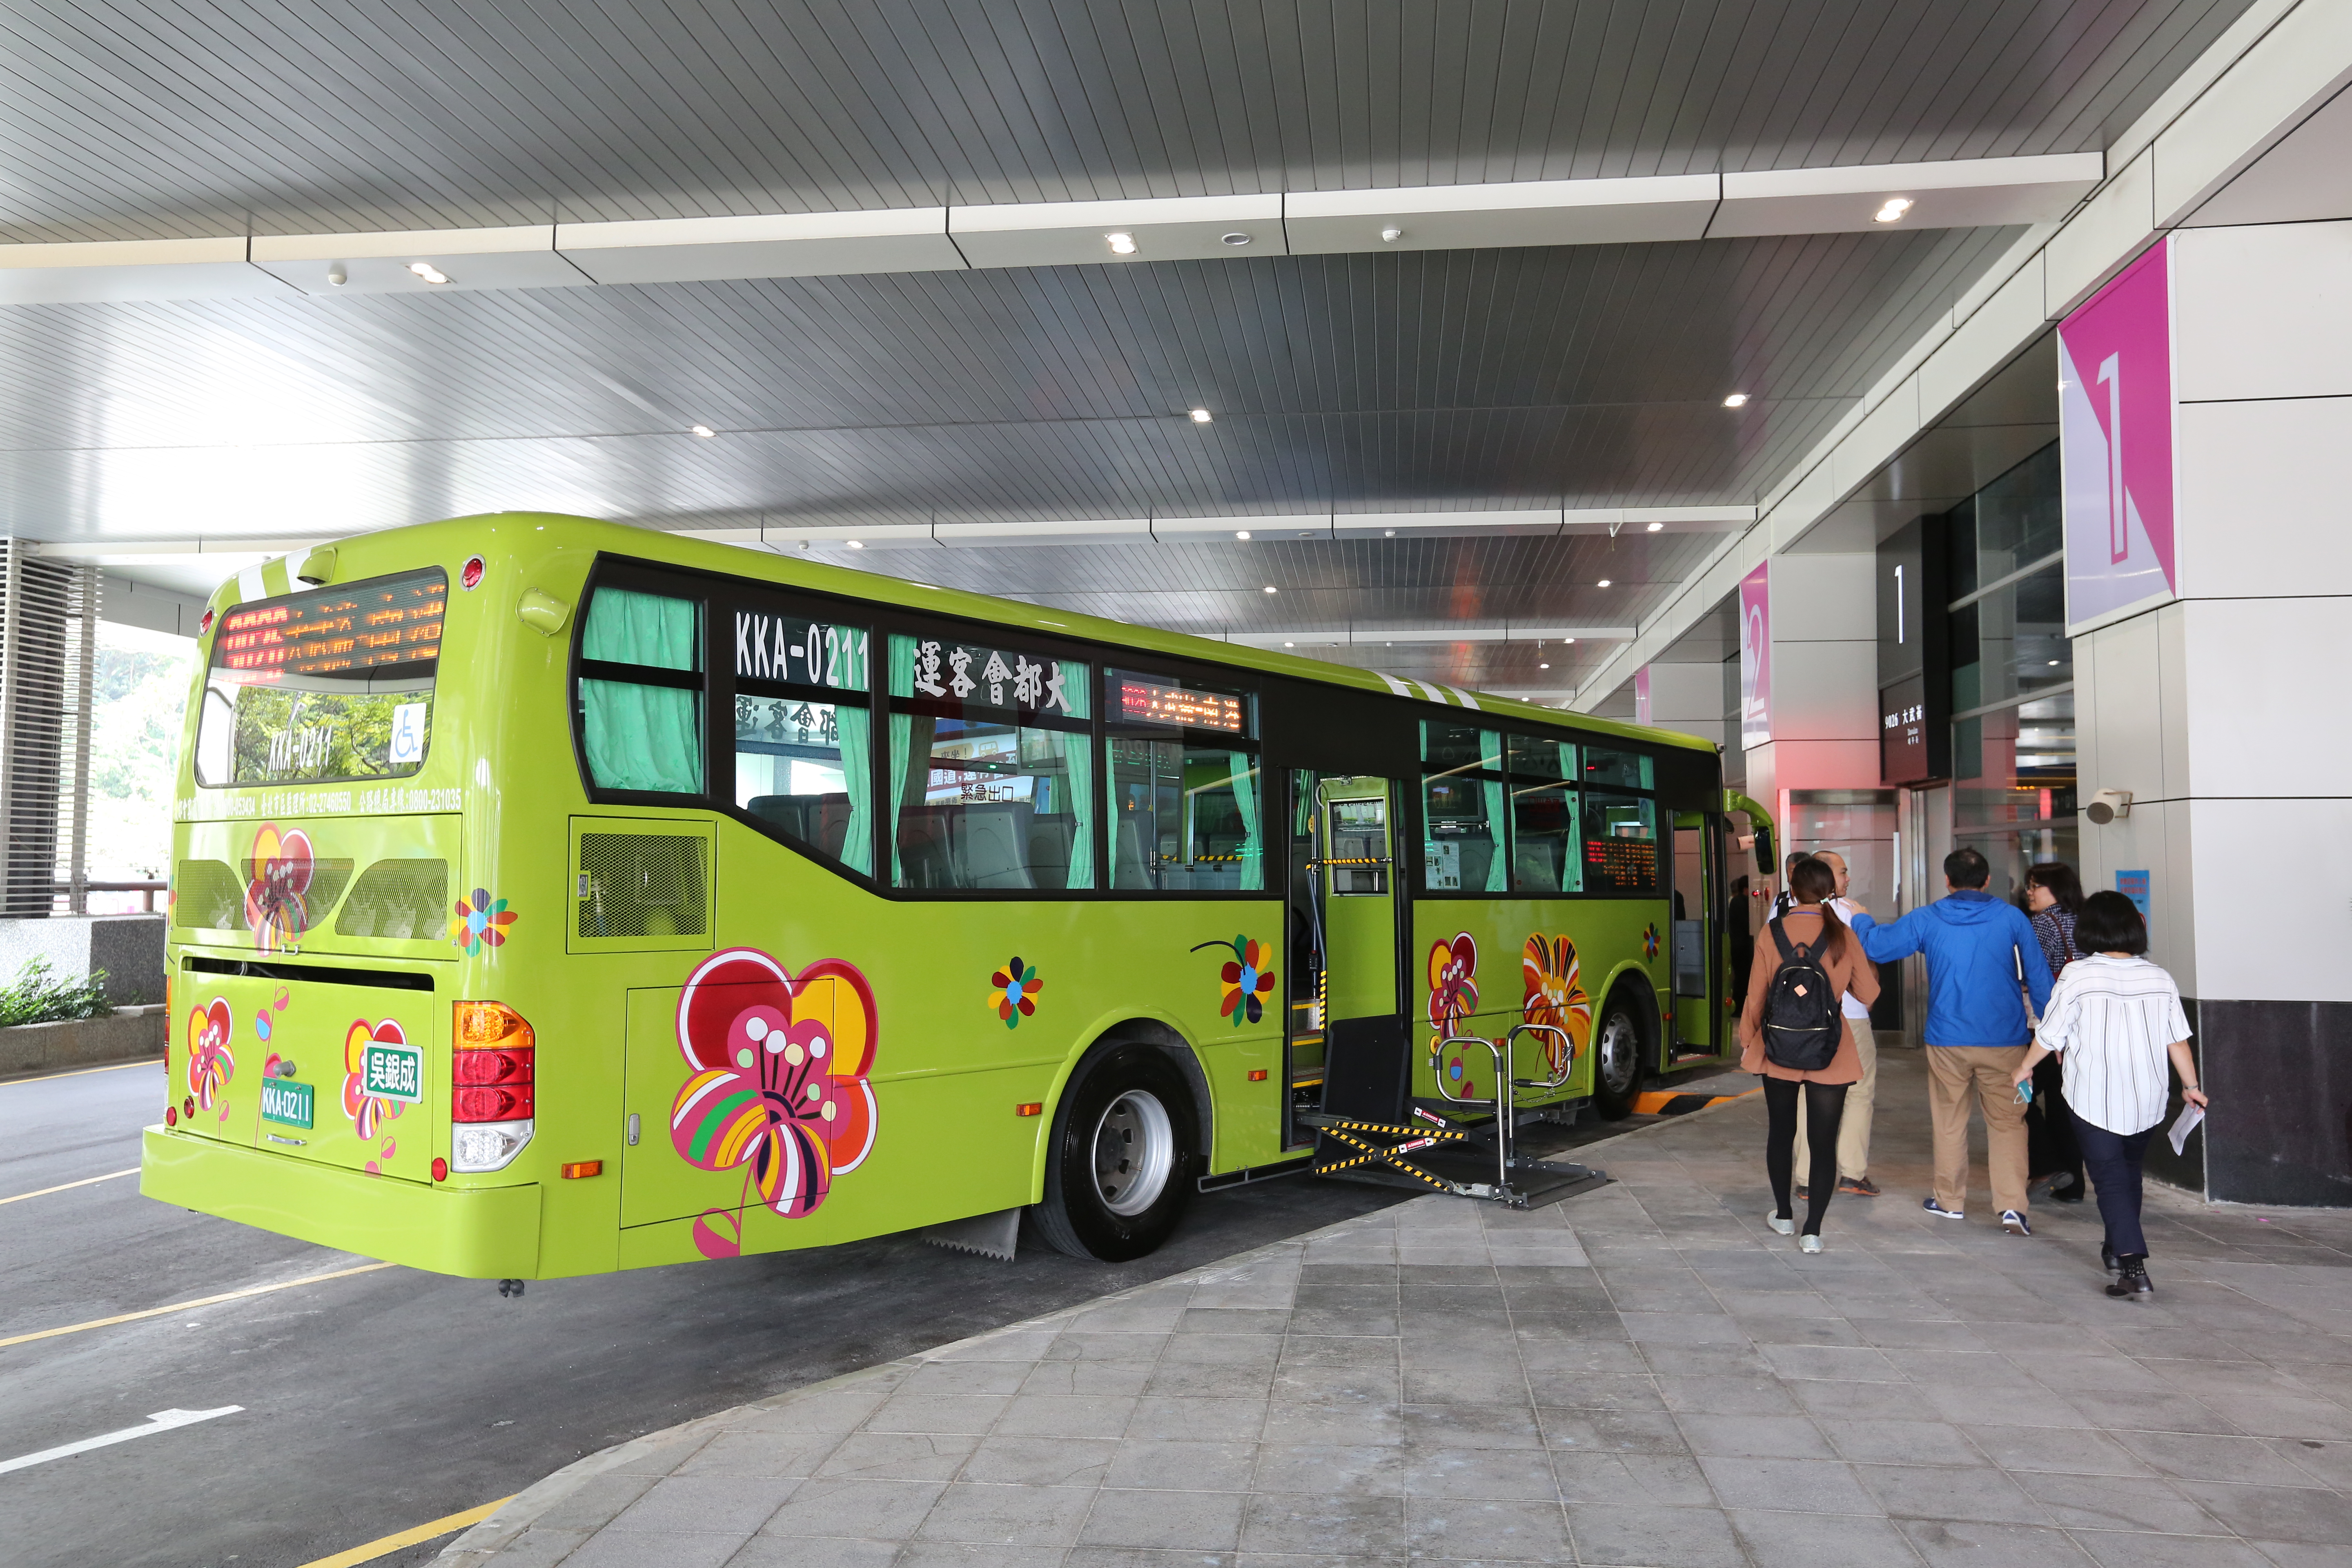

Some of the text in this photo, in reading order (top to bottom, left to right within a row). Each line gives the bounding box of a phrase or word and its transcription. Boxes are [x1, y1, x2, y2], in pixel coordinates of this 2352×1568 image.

[2096, 351, 2128, 566] 1
[1894, 564, 1903, 644] 1
[735, 611, 869, 690] KKA-0211
[1747, 604, 1765, 720] 2
[1884, 712, 1899, 729] 9026
[268, 724, 332, 771] KKA-0211
[960, 783, 1013, 802] 緊急出口
[370, 1052, 416, 1094] 吳銀成
[1426, 1113, 1438, 1121] DANGER
